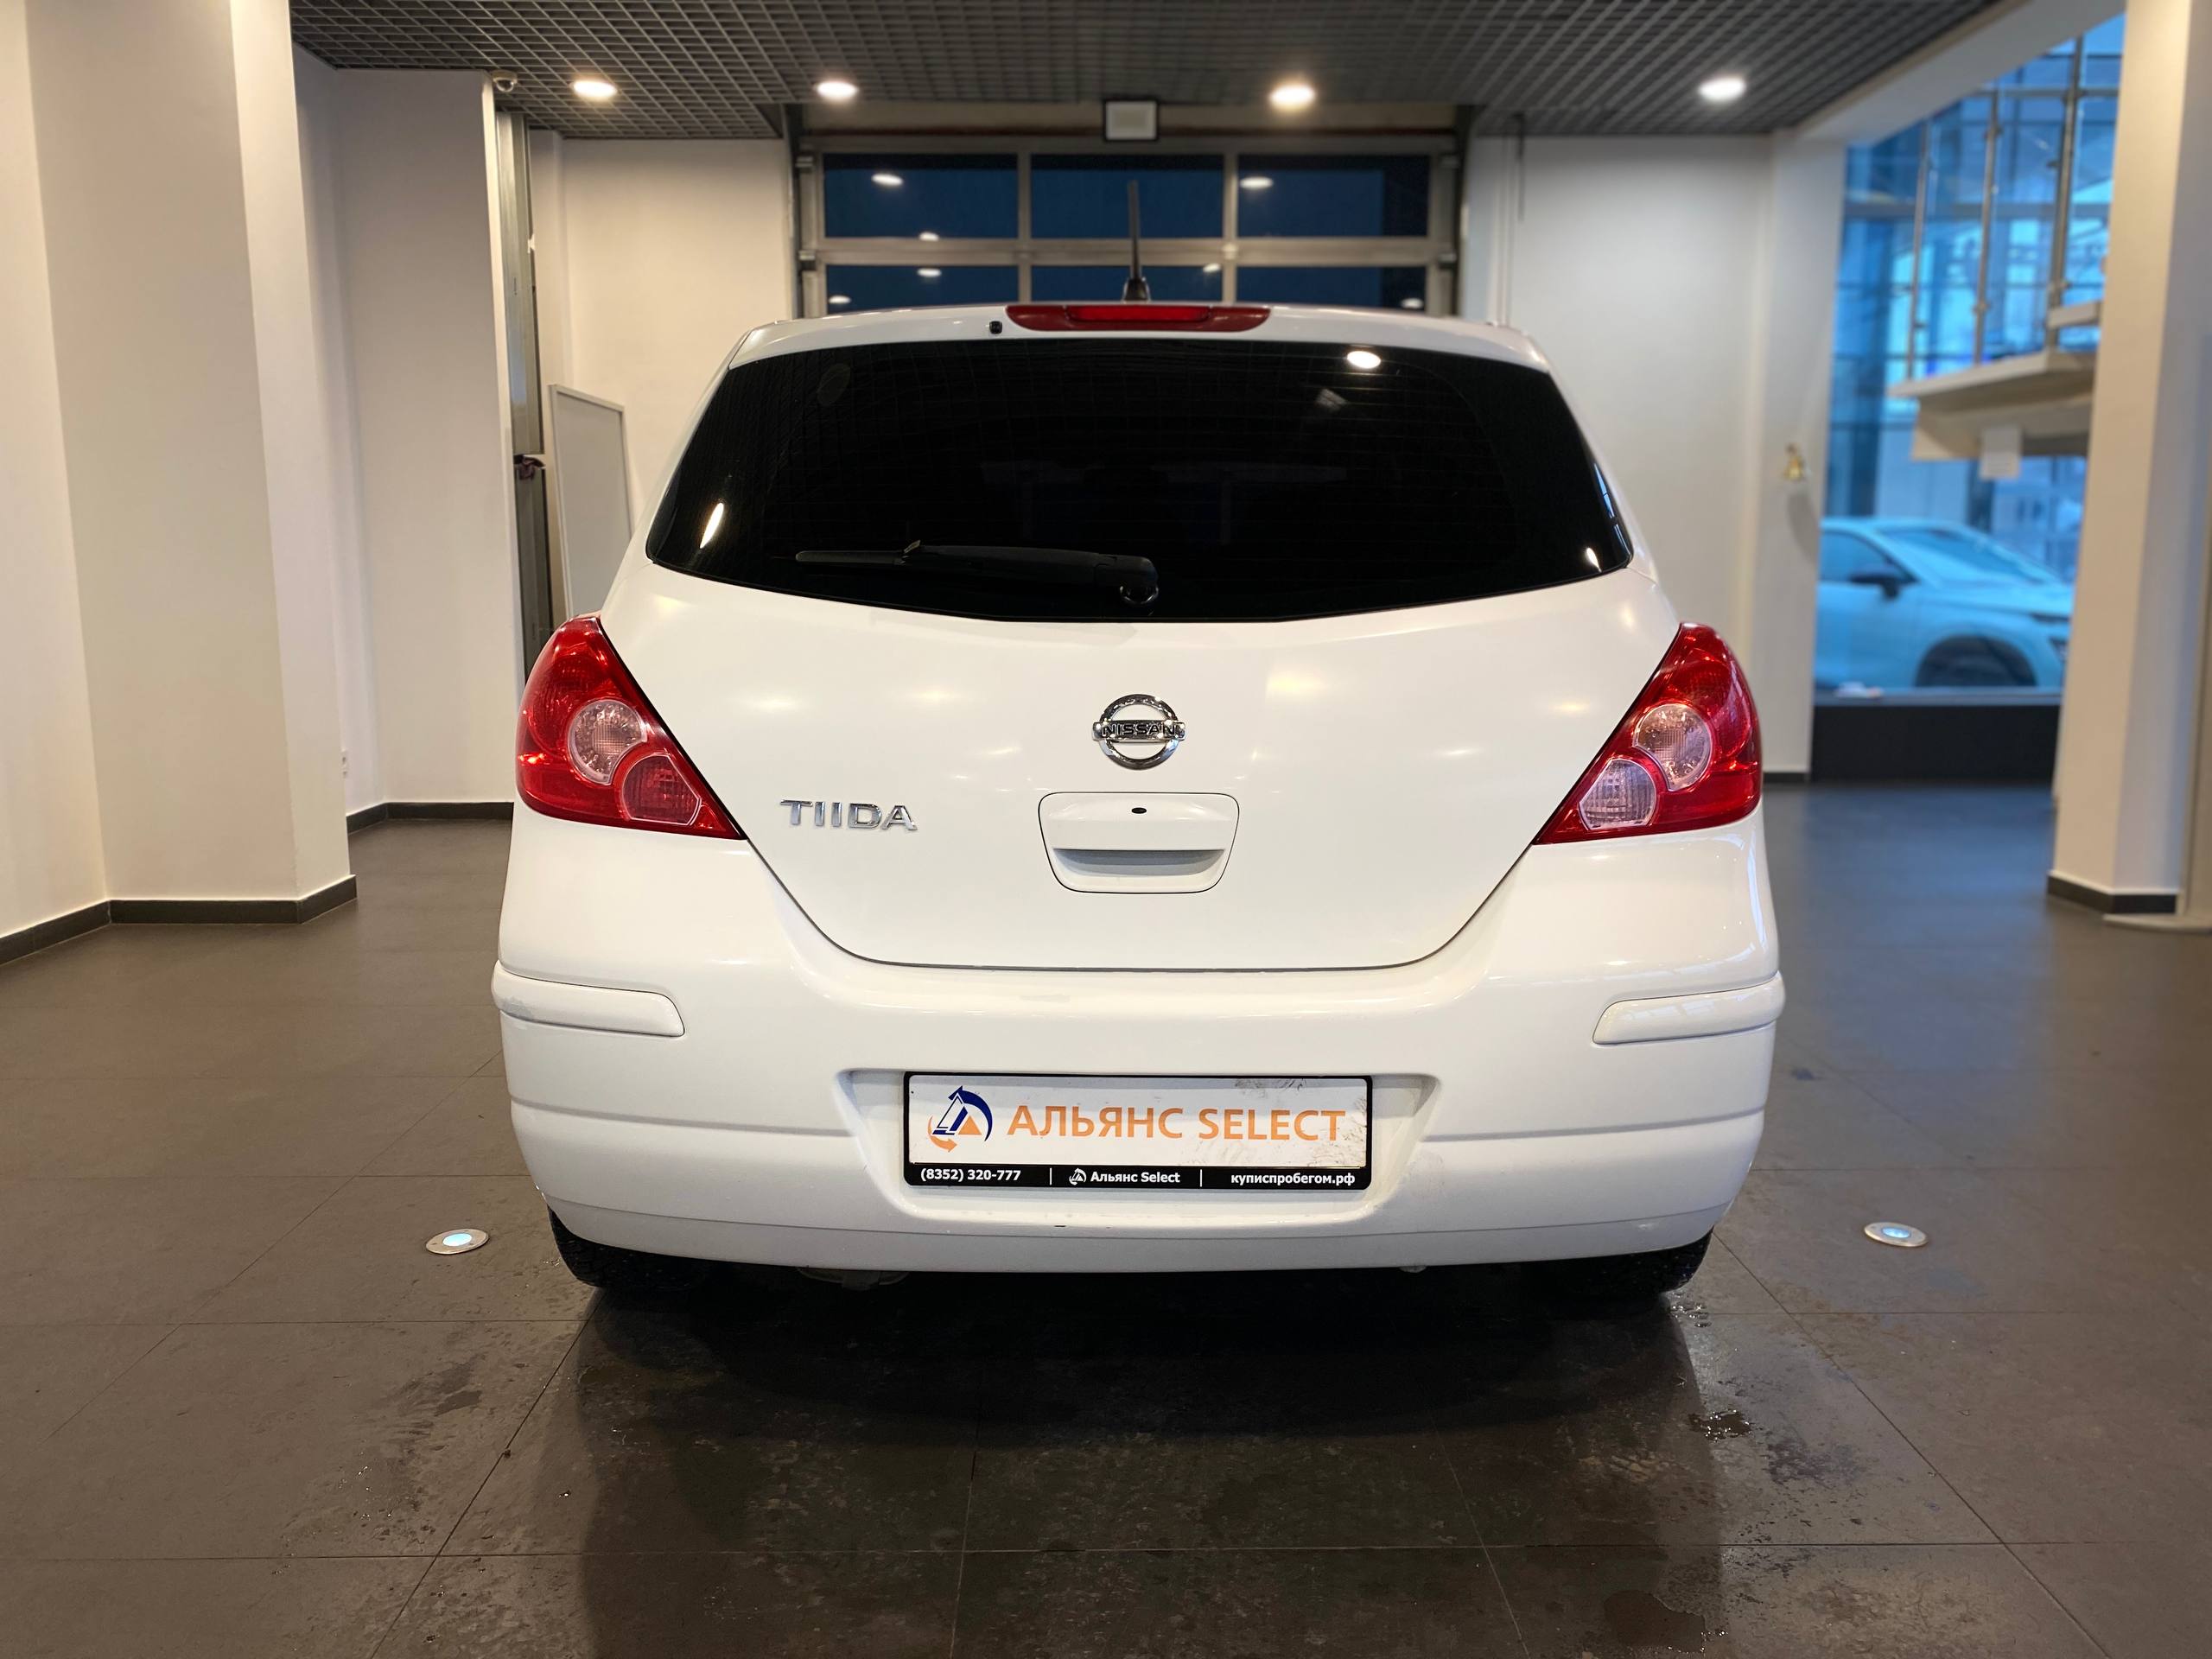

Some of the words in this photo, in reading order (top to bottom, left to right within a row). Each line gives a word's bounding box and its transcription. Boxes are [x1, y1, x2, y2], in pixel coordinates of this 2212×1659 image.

[1103, 723, 1176, 735] NISSAN
[780, 799, 918, 831] TIIDA
[1007, 1105, 1183, 1138] АЛЬЯНС
[1198, 1108, 1346, 1141] SELECT
[920, 1167, 964, 1182] (8352)
[967, 1169, 1021, 1181] 320-777
[1090, 1171, 1138, 1183] Альянс
[1141, 1172, 1180, 1184] Select
[1230, 1173, 1356, 1186] куписпробегом.рф
